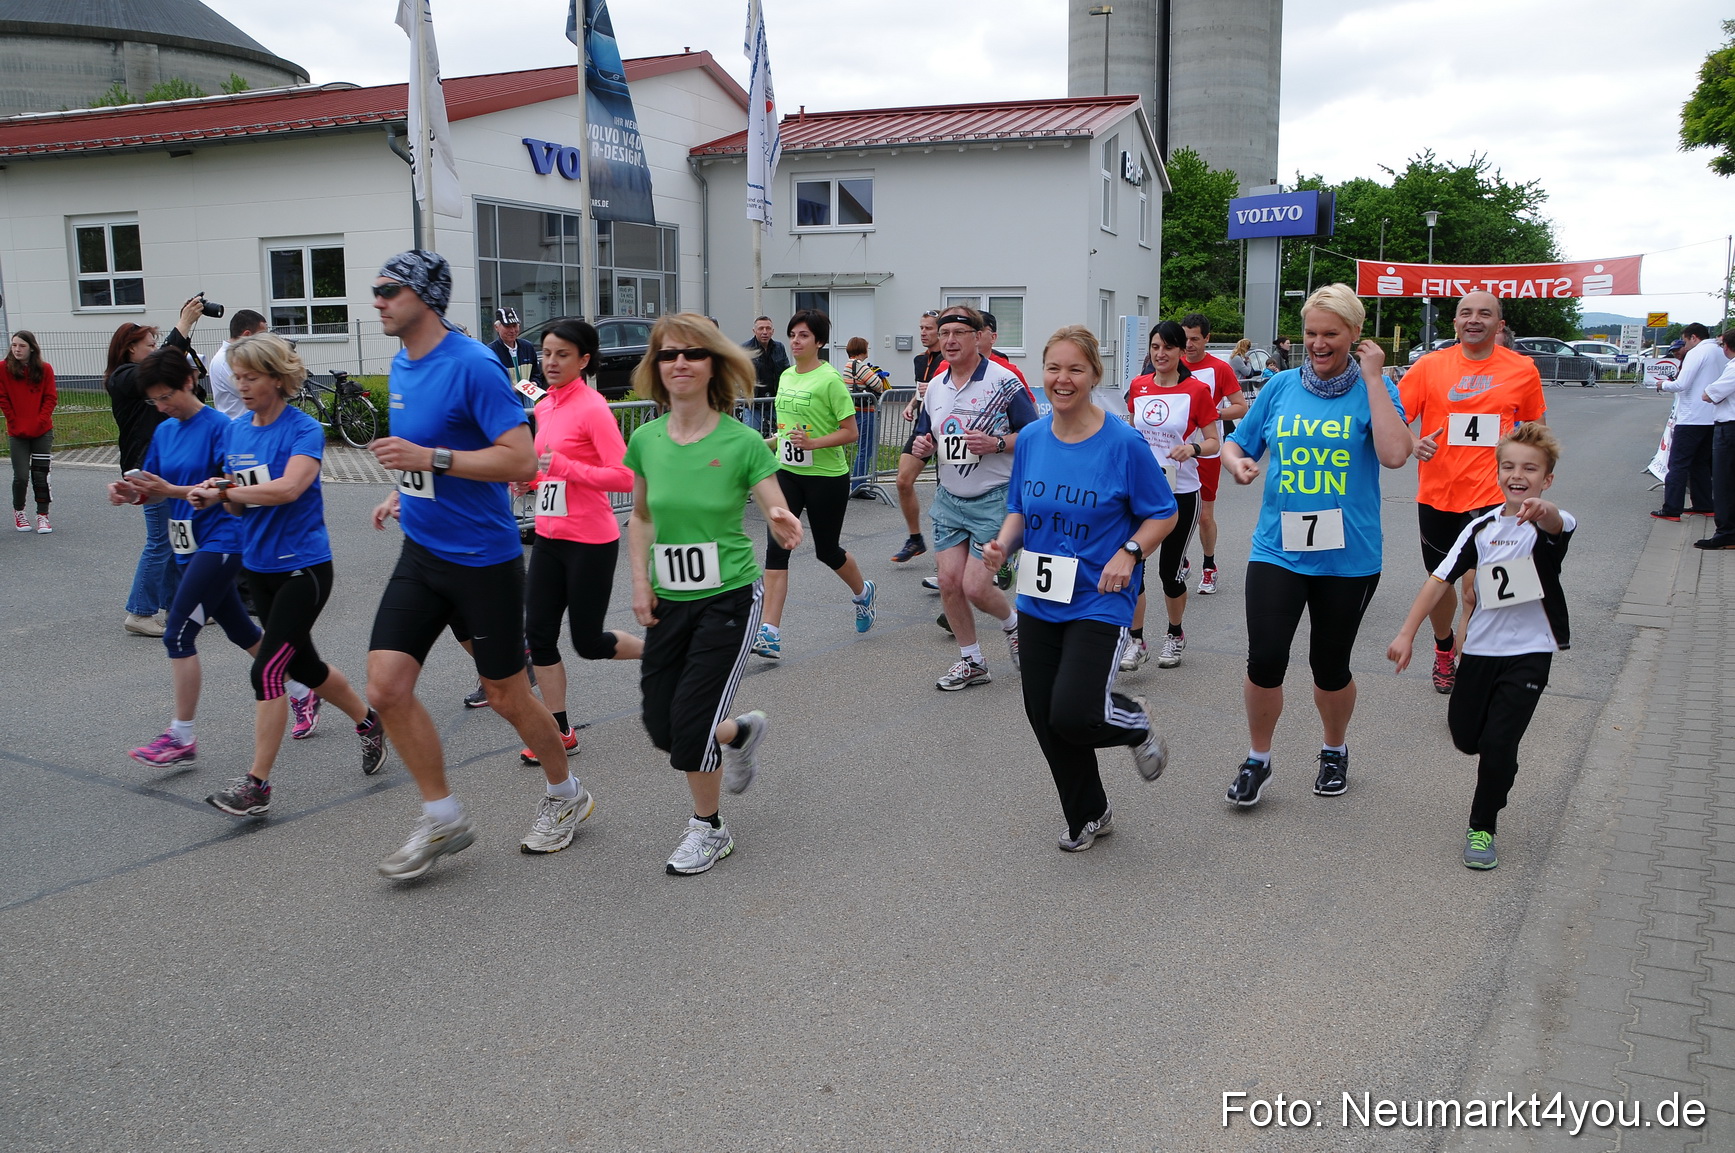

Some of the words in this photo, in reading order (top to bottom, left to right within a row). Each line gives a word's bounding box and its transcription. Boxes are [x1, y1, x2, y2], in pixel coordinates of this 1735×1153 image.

[586, 123, 619, 144] VOLVO
[622, 130, 641, 150] V40
[591, 141, 644, 168] R-DESIGN.
[1236, 205, 1303, 225] VOLVO
[520, 382, 538, 396] 45
[1457, 375, 1493, 390] RUN
[1277, 414, 1352, 439] Live!
[1465, 416, 1479, 441] 4
[785, 441, 805, 463] 38
[944, 436, 968, 460] 127
[1277, 442, 1350, 467] Love
[1023, 480, 1046, 498] no
[1054, 484, 1098, 508] run
[1279, 470, 1347, 495] RUN
[541, 484, 558, 511] 37
[171, 522, 189, 549] 28
[1052, 512, 1090, 540] fun
[1302, 514, 1318, 546] 7
[664, 547, 706, 583] 110
[1036, 556, 1052, 593] 5
[1491, 566, 1515, 600] 2
